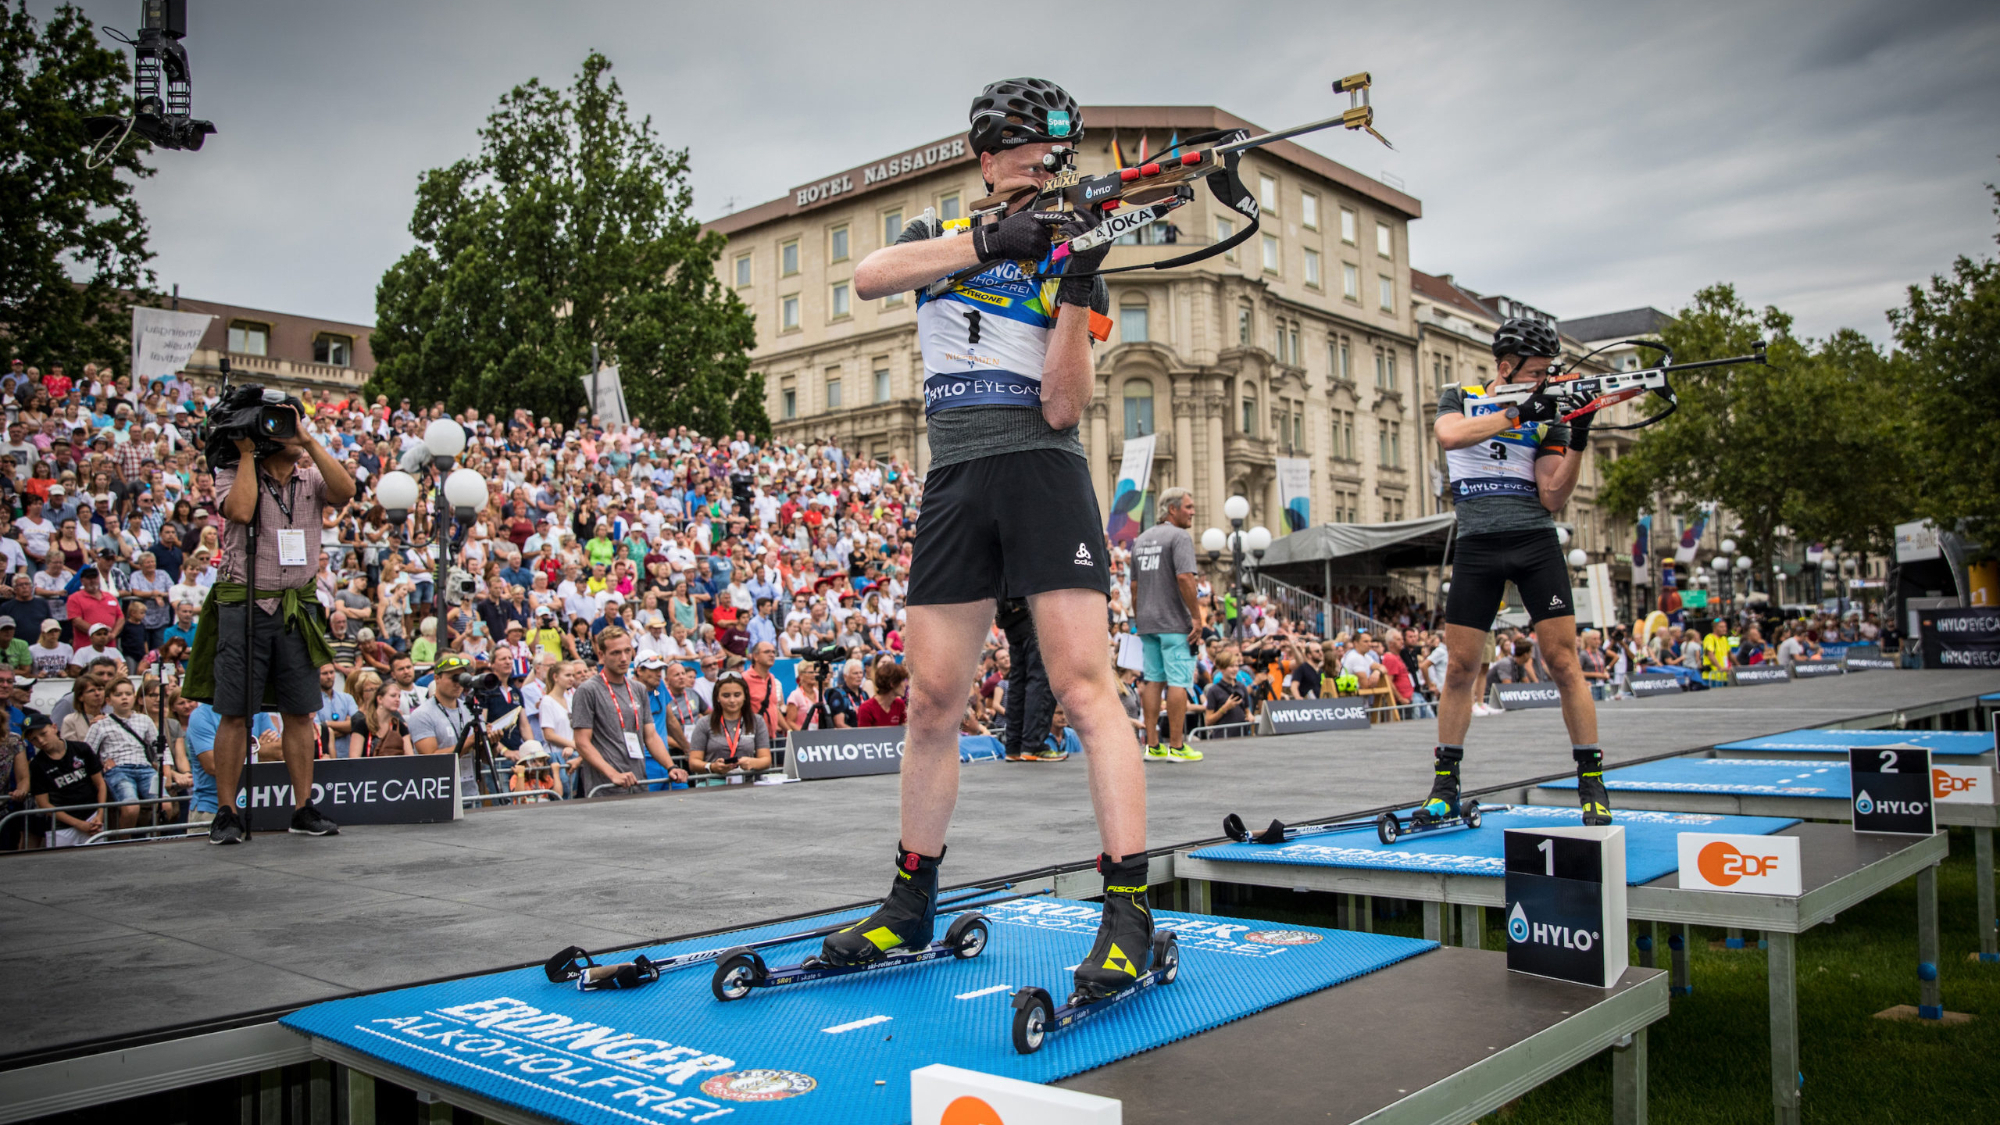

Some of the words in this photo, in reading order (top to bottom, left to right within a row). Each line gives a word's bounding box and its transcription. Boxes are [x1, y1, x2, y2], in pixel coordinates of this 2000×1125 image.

[1048, 118, 1070, 126] Spare
[796, 175, 853, 206] HOTEL
[863, 138, 966, 185] NASSAUER
[1093, 186, 1110, 196] HYLO
[1106, 210, 1152, 237] JOKA
[963, 309, 981, 344] 1
[930, 382, 966, 402] HYLO
[975, 379, 1005, 394] EYE
[1490, 441, 1508, 460] 3
[1469, 483, 1498, 493] HYLO
[1137, 555, 1160, 570] TEAM
[1940, 617, 1967, 632] HYLO
[1969, 617, 1986, 631] EYE
[1986, 616, 2000, 631] CA
[1989, 651, 2000, 665] CA
[1506, 690, 1529, 701] HYLO
[1546, 689, 1560, 700] CA
[1278, 709, 1310, 722] HYLO
[1313, 709, 1335, 720] EYE
[1335, 707, 1366, 719] CARE
[807, 744, 859, 762] HYLO
[863, 742, 895, 759] EYE
[1879, 750, 1899, 773] 2
[334, 781, 377, 804] EYE
[382, 776, 451, 802] CARE
[1938, 776, 1977, 792] ZDF
[1537, 838, 1554, 876] 1
[1722, 852, 1778, 877] ZDF
[1107, 884, 1147, 893] FISCHE
[987, 898, 1250, 939] ERDIGER
[436, 996, 736, 1086] ERDINGER
[371, 1015, 735, 1123] ALKOHOLFREI
